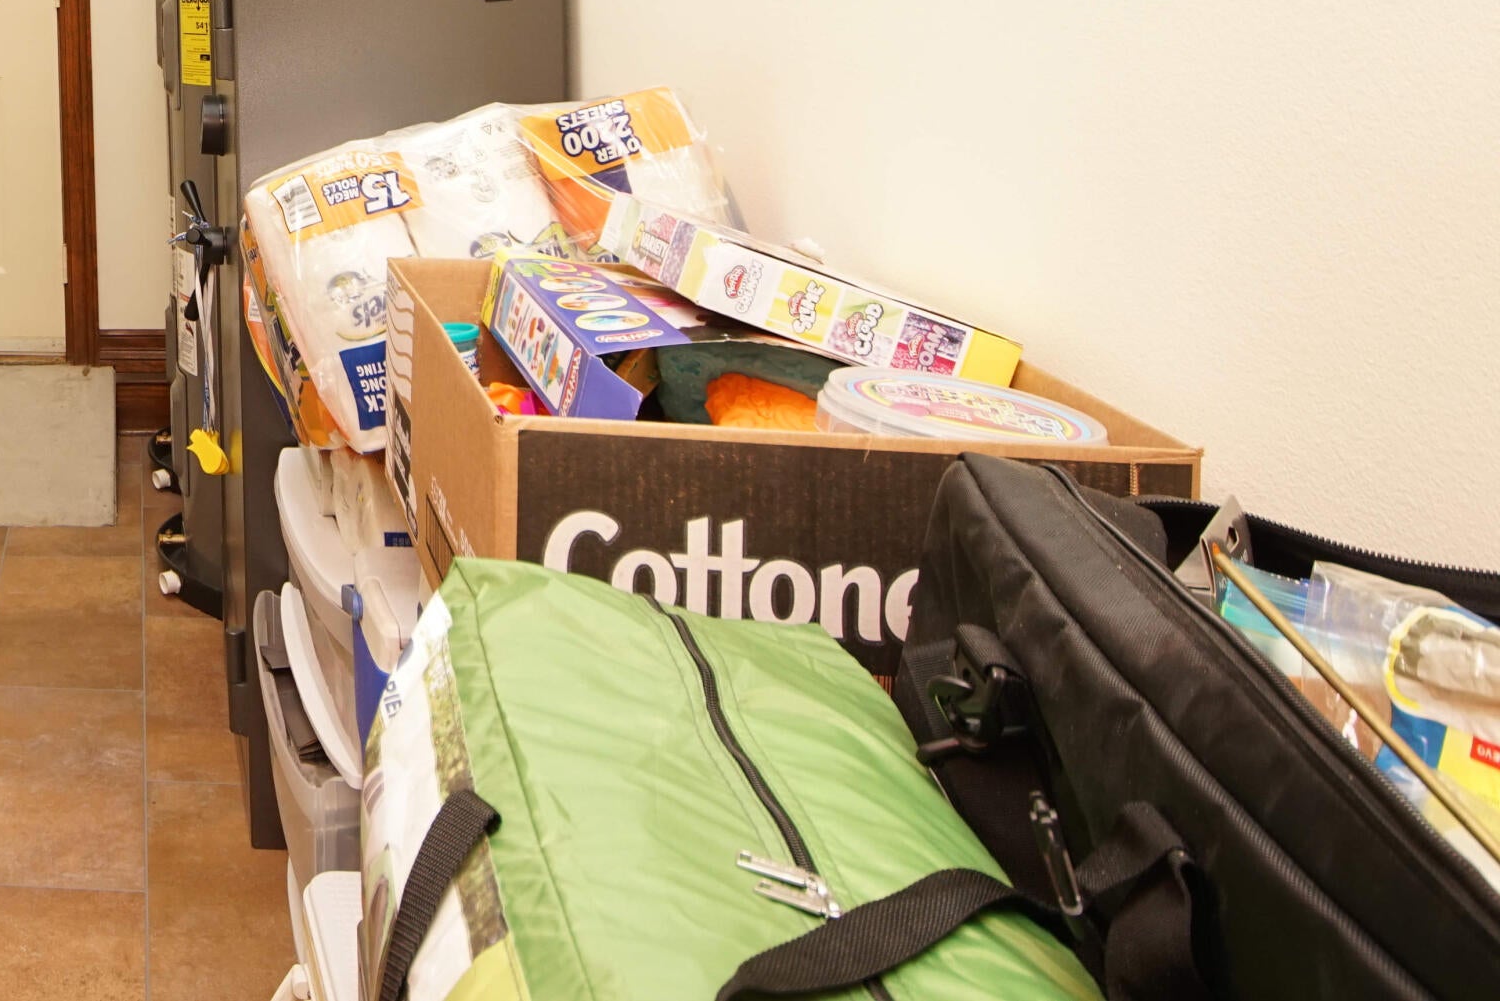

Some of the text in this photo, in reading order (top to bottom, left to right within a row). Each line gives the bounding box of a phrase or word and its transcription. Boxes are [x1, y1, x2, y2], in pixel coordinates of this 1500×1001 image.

[556, 99, 624, 132] SHEETS
[595, 137, 641, 164] OVER
[322, 176, 358, 196] ROLLS
[325, 171, 412, 214] 15 MEGA
[852, 303, 884, 356] CLOUD
